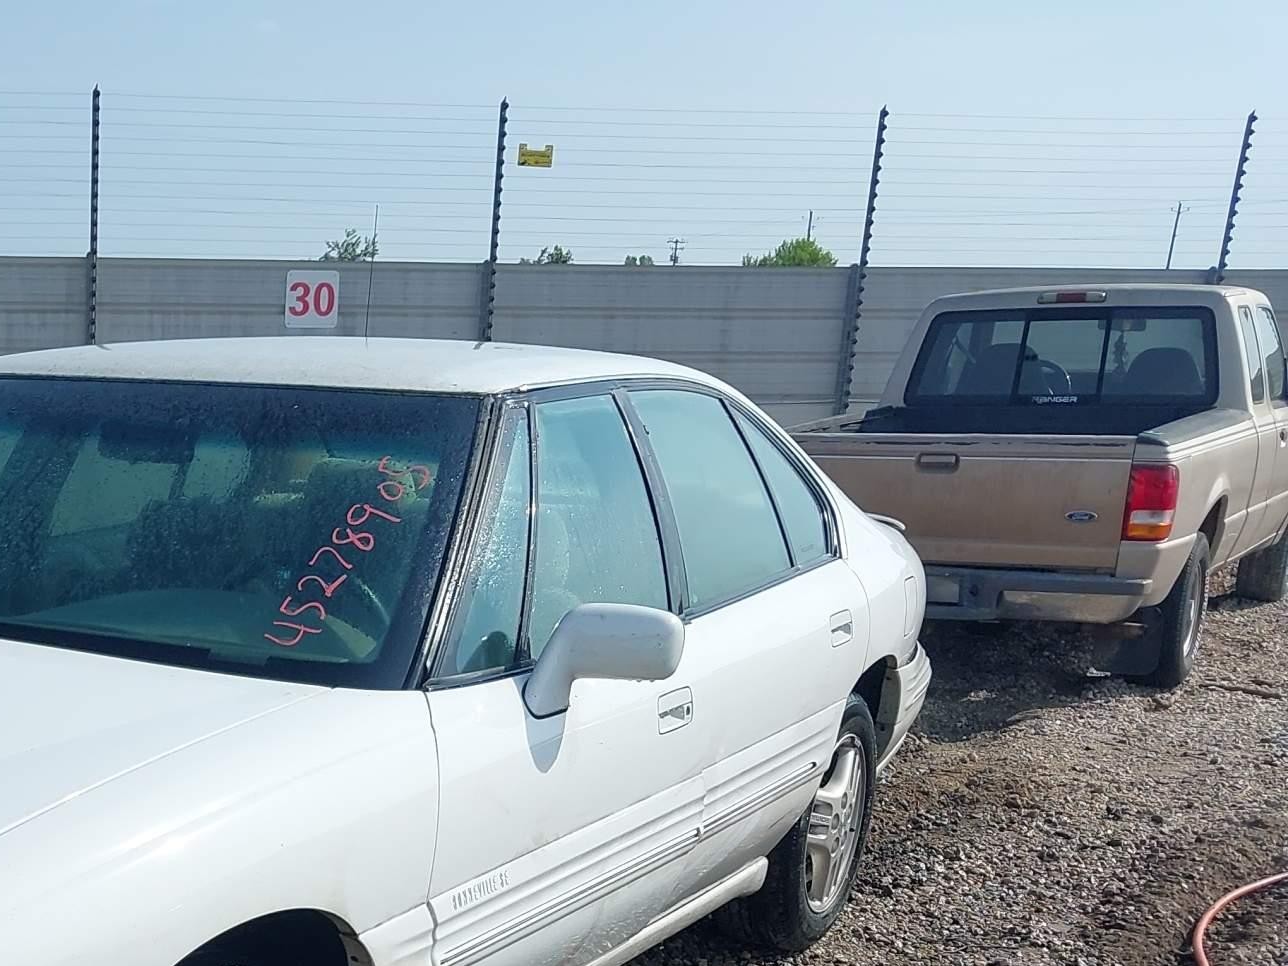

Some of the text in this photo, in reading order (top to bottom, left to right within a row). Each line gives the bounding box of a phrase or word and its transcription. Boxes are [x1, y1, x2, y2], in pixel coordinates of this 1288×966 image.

[288, 281, 336, 317] 30
[264, 455, 431, 646] 45278905
[452, 870, 510, 910] BONNEVILLE SE
